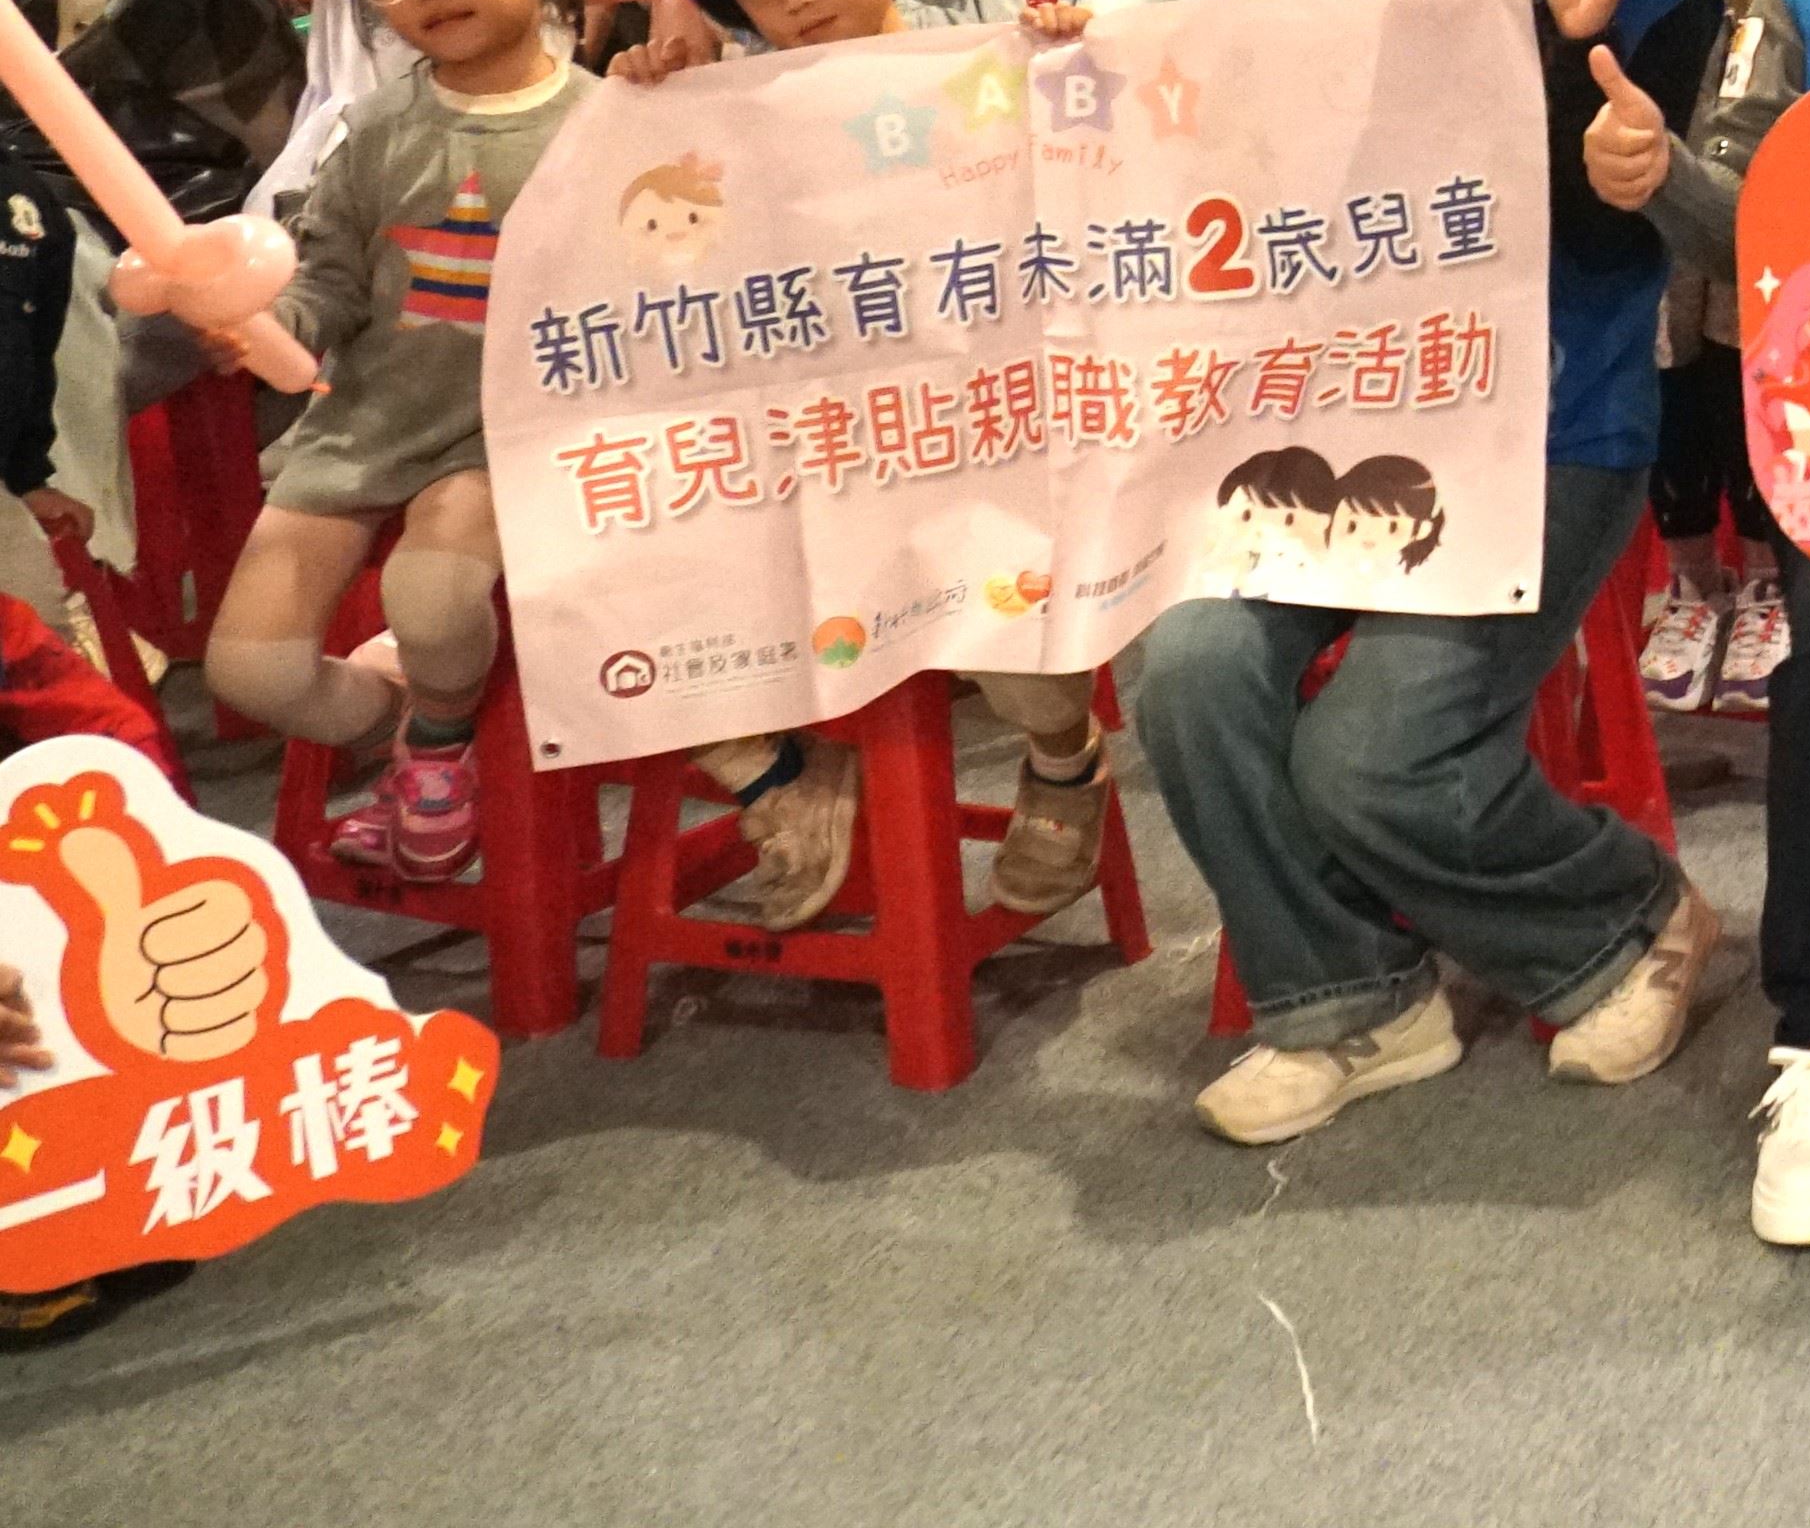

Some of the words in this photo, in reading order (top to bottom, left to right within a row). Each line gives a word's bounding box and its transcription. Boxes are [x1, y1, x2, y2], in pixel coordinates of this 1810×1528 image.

[875, 73, 1184, 157] BABY
[530, 175, 1496, 390] 新竹縣育有未滿2歲兒童
[557, 311, 1495, 529] 育兒津貼親職教育活動
[0, 1035, 420, 1236] 一級棒
